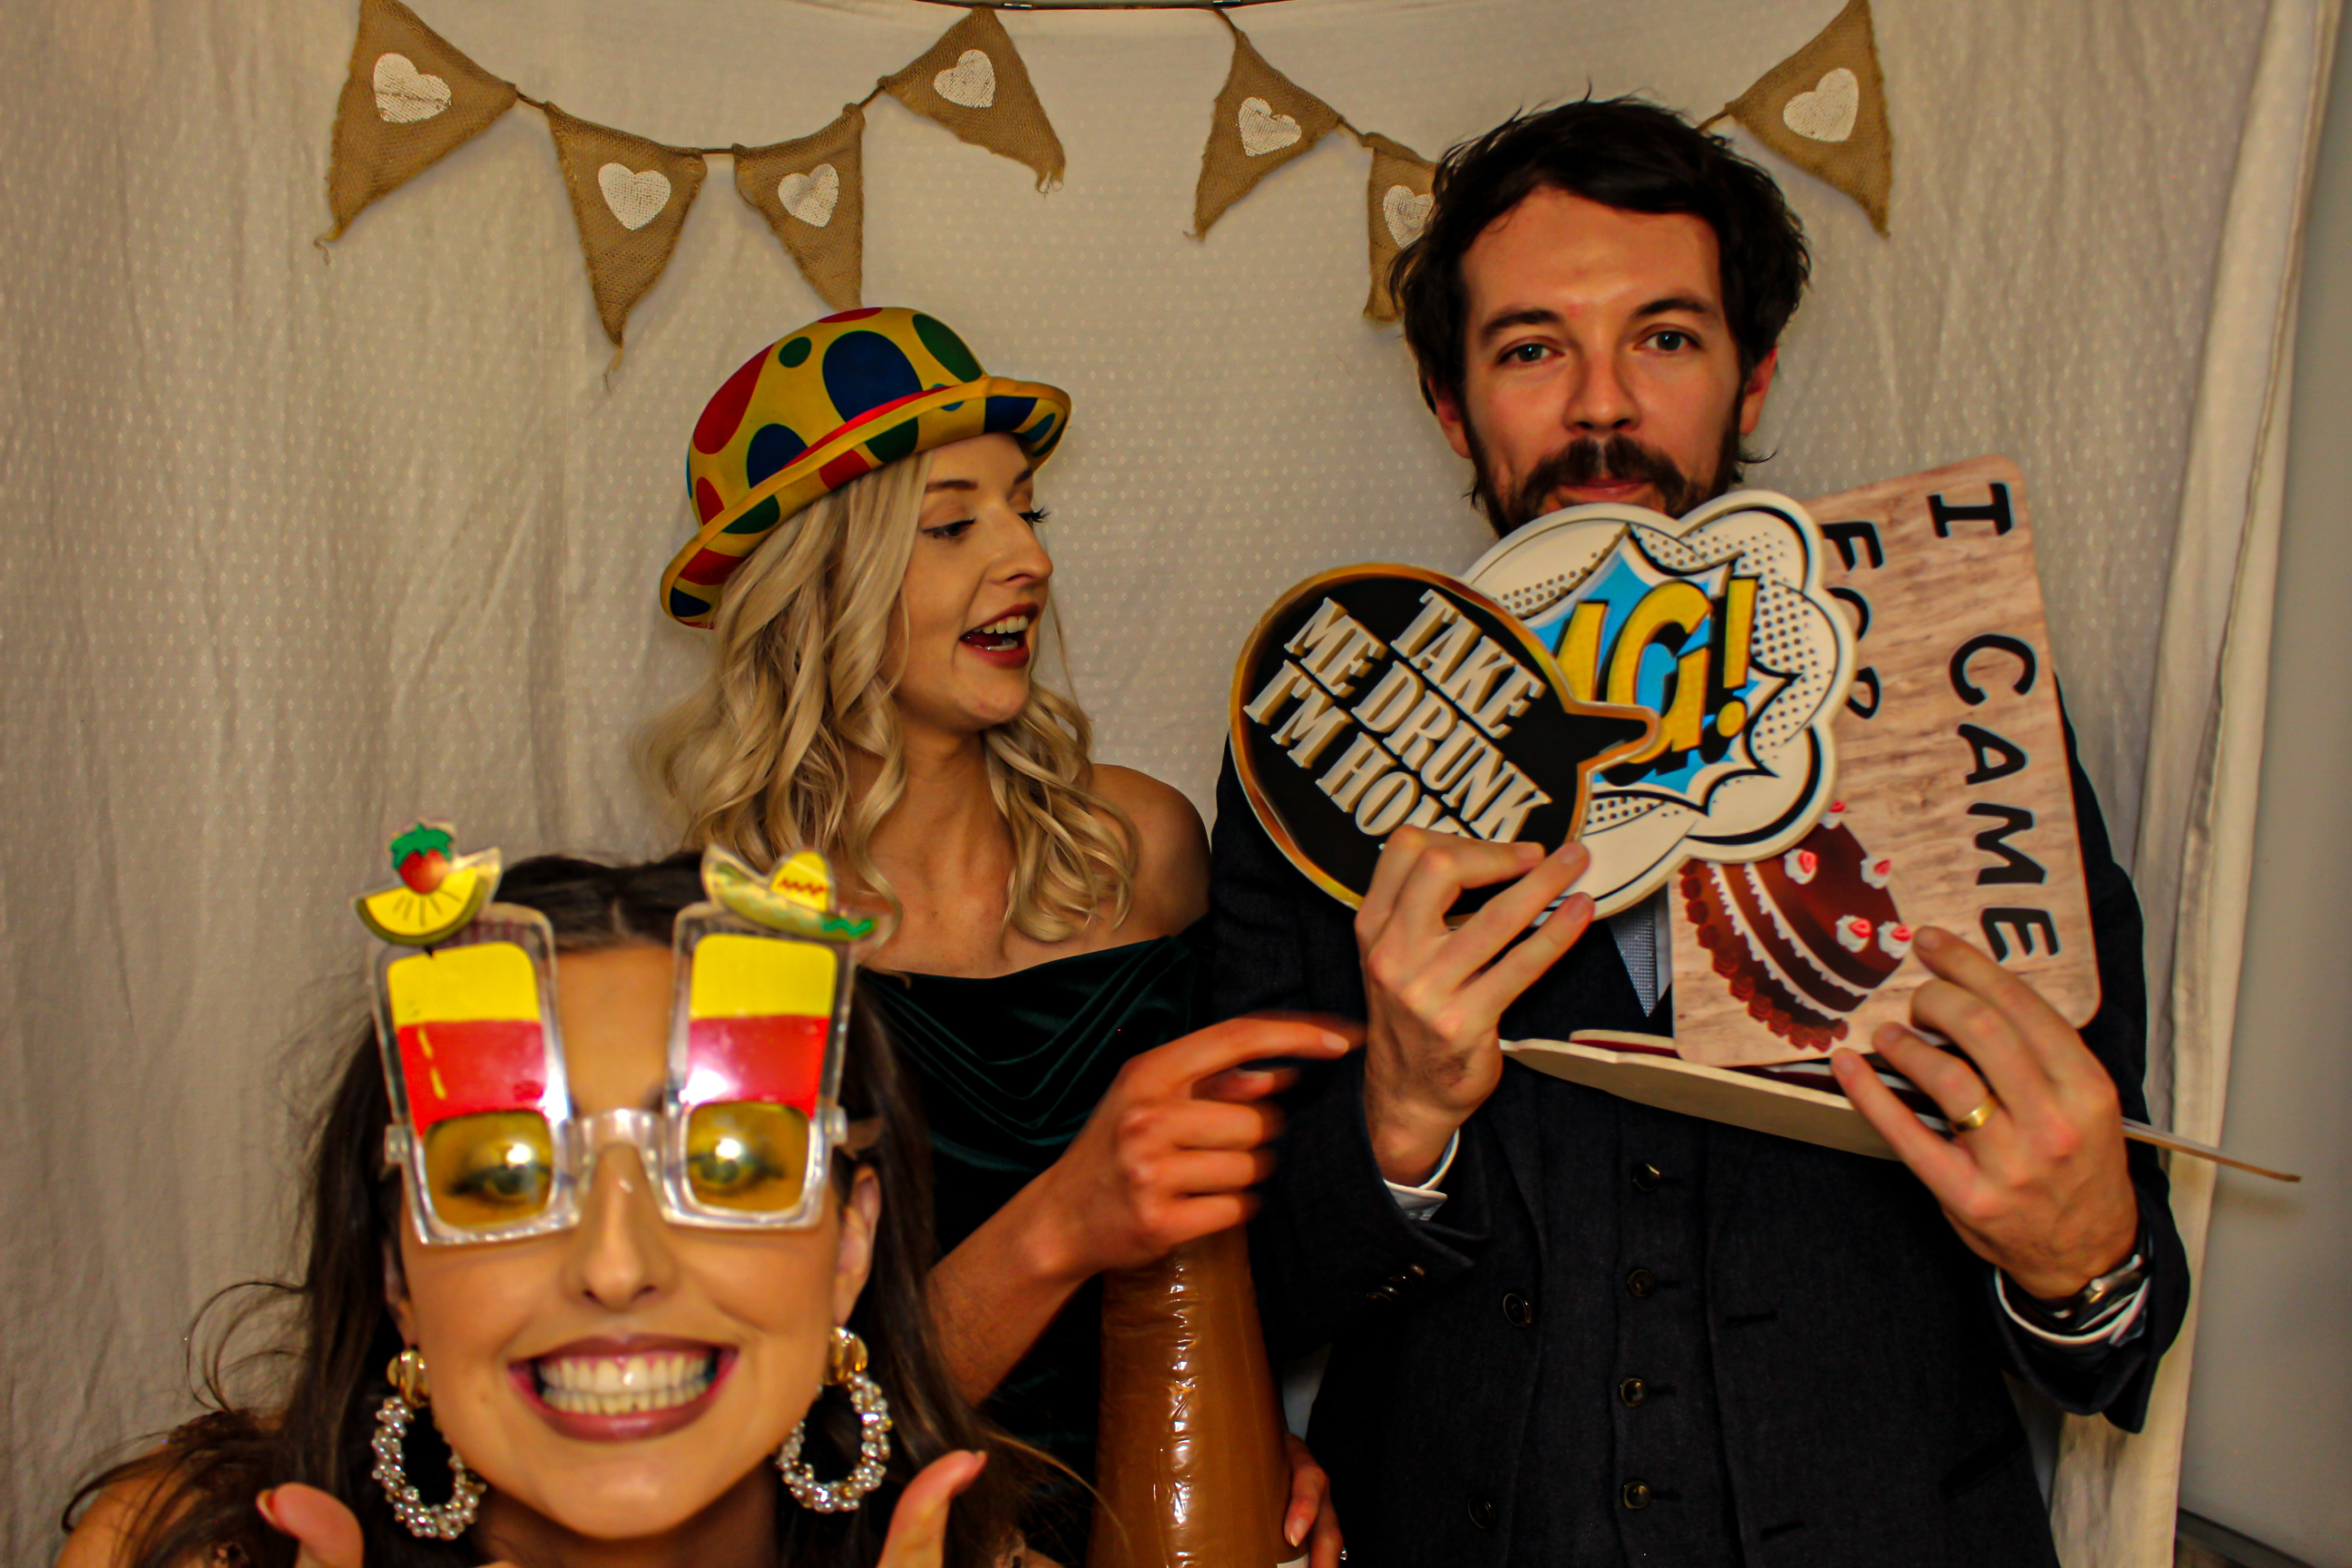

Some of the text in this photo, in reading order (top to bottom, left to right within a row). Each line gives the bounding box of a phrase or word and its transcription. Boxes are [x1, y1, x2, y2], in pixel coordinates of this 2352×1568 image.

[1243, 659, 1475, 840] I'M HO
[1284, 596, 1553, 845] ME DRUNK
[1390, 588, 1547, 740] TAKE
[1927, 482, 2061, 963] I CAME
